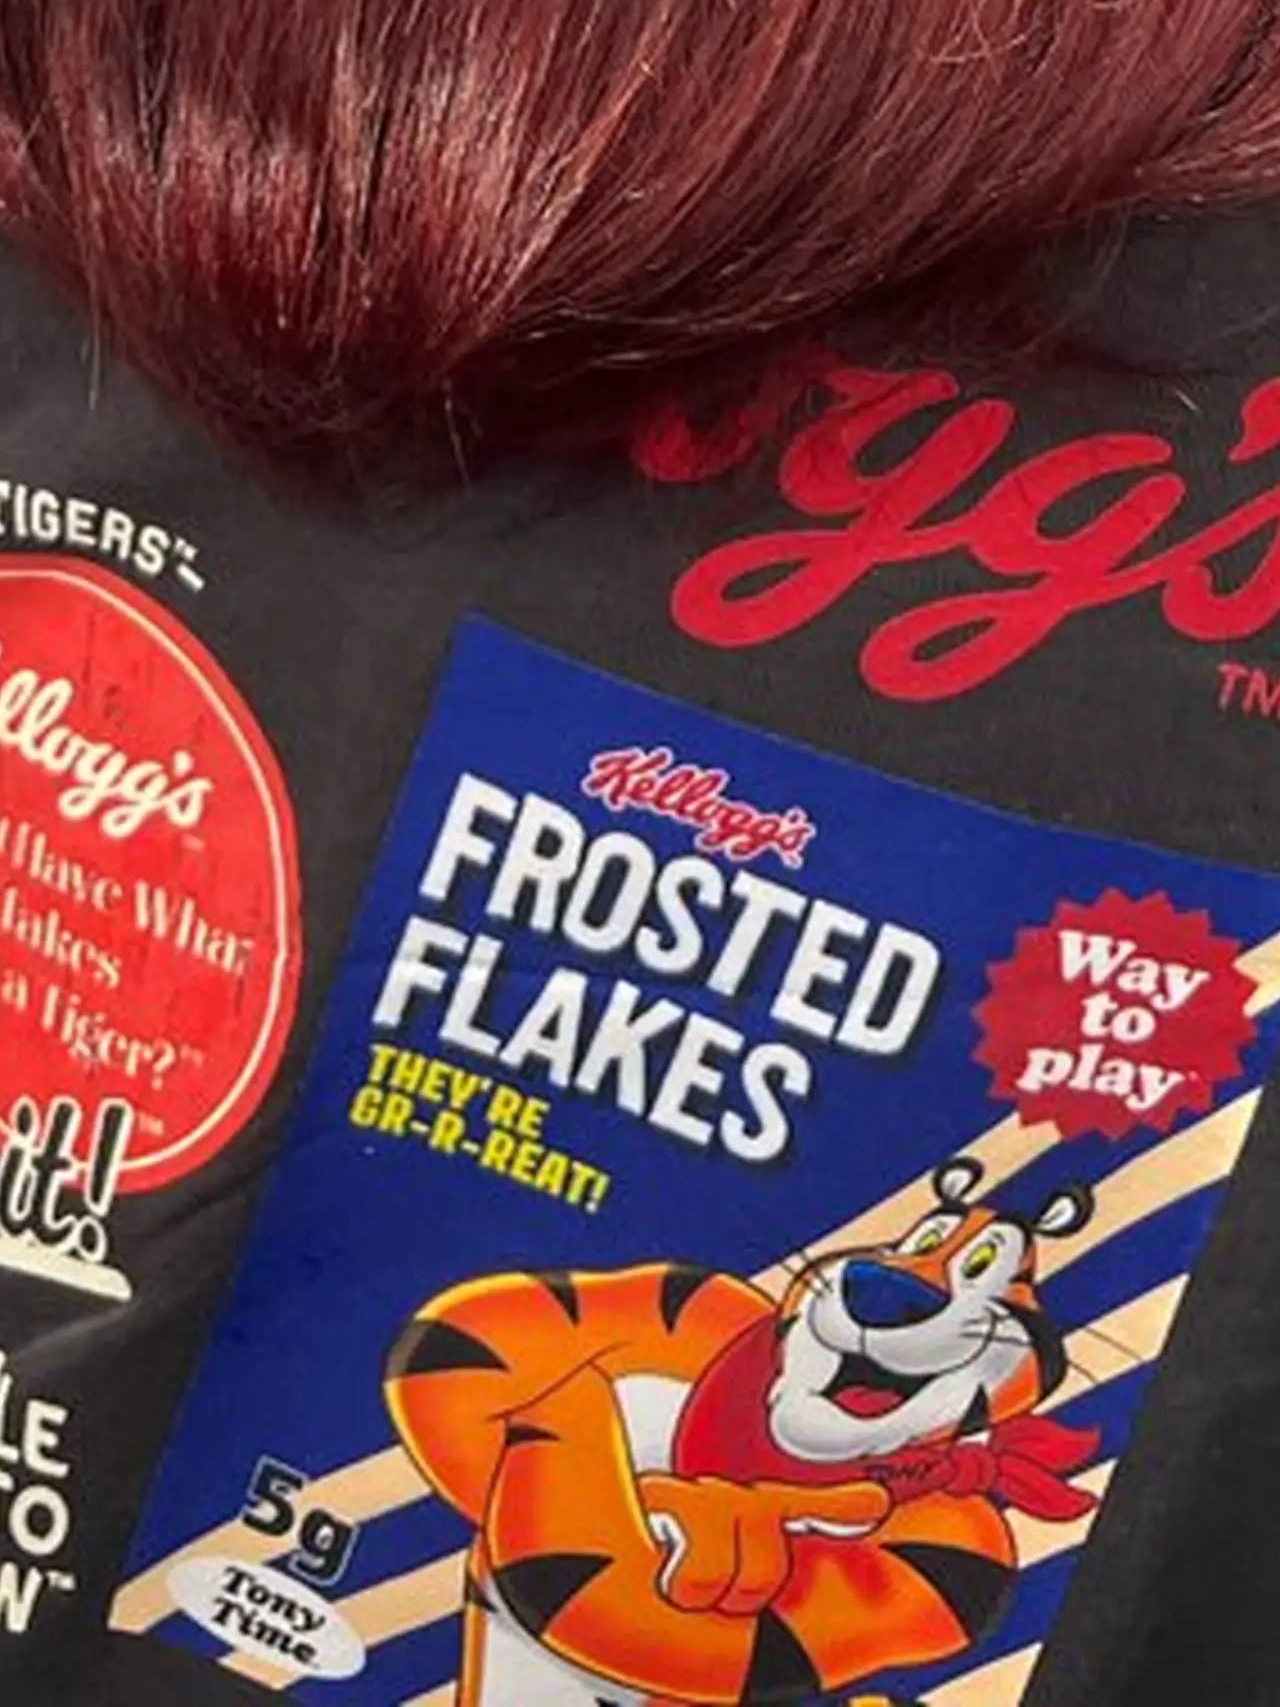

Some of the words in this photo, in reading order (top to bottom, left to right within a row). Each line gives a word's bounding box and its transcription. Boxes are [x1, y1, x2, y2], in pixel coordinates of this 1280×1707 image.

[581, 747, 816, 859] Kellogg's
[11, 822, 123, 911] Have
[420, 773, 941, 1054] FROSTED
[1, 971, 28, 1012] a
[1058, 929, 1210, 1011] Way
[372, 915, 812, 1161] FLAKES
[1081, 992, 1156, 1043] to
[369, 1044, 551, 1138] THEY'RE
[1016, 1044, 1185, 1111] play
[348, 1084, 610, 1215] GR-R-REAT!
[240, 1454, 361, 1587] 5g
[212, 1597, 317, 1665] Time
[223, 1564, 326, 1633] Tony
